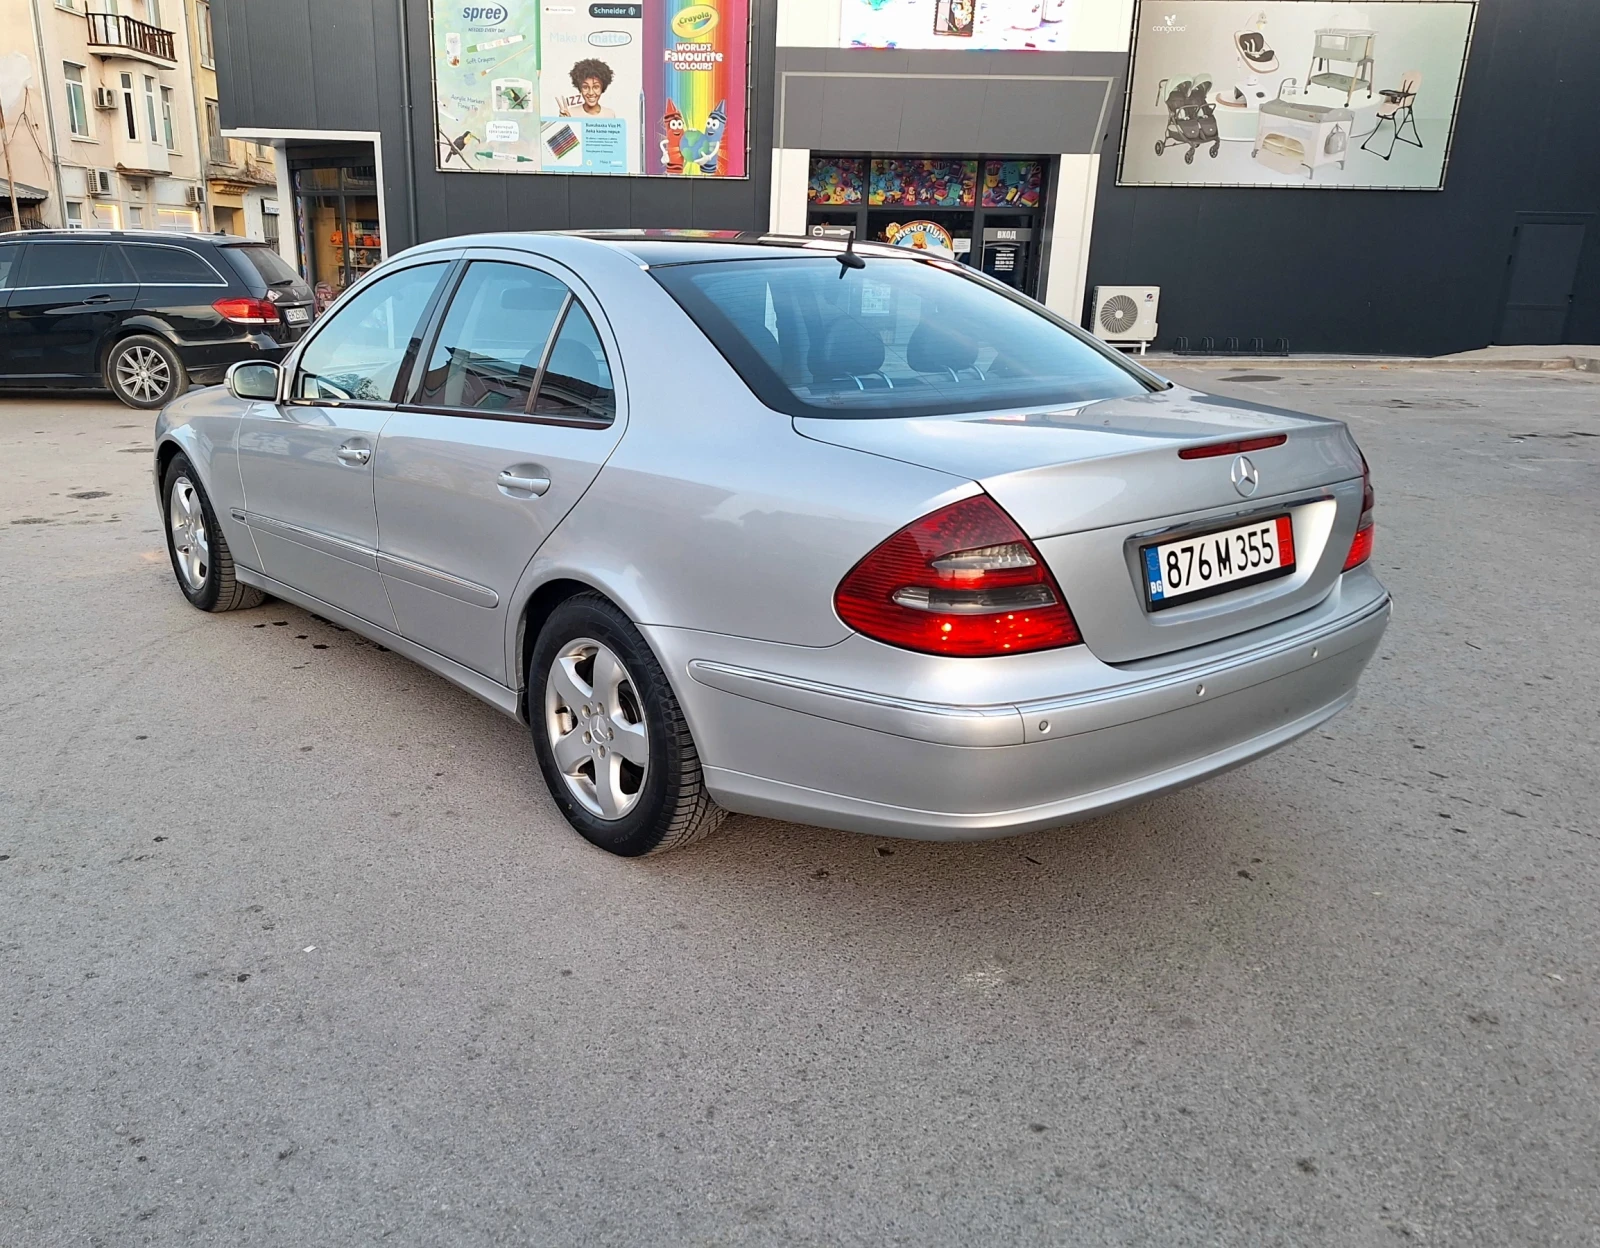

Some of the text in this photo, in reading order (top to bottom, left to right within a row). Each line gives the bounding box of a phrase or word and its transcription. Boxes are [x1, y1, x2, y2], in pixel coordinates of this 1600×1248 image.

[463, 7, 502, 22] spree
[593, 7, 627, 15] Schneider
[679, 11, 710, 25] Crayola
[1152, 25, 1186, 34] cangaroo
[549, 32, 578, 43] Make
[590, 33, 629, 44] matter
[676, 43, 712, 51] WORLD'S
[466, 56, 496, 65] Soft Crayons
[664, 50, 724, 62] Favourite
[674, 62, 713, 70] COLOURS
[467, 96, 485, 105] Markers
[926, 223, 946, 242] Пух
[996, 230, 1017, 240] ВХОД
[1166, 527, 1274, 589] 876 M 355
[1150, 580, 1163, 594] BG
